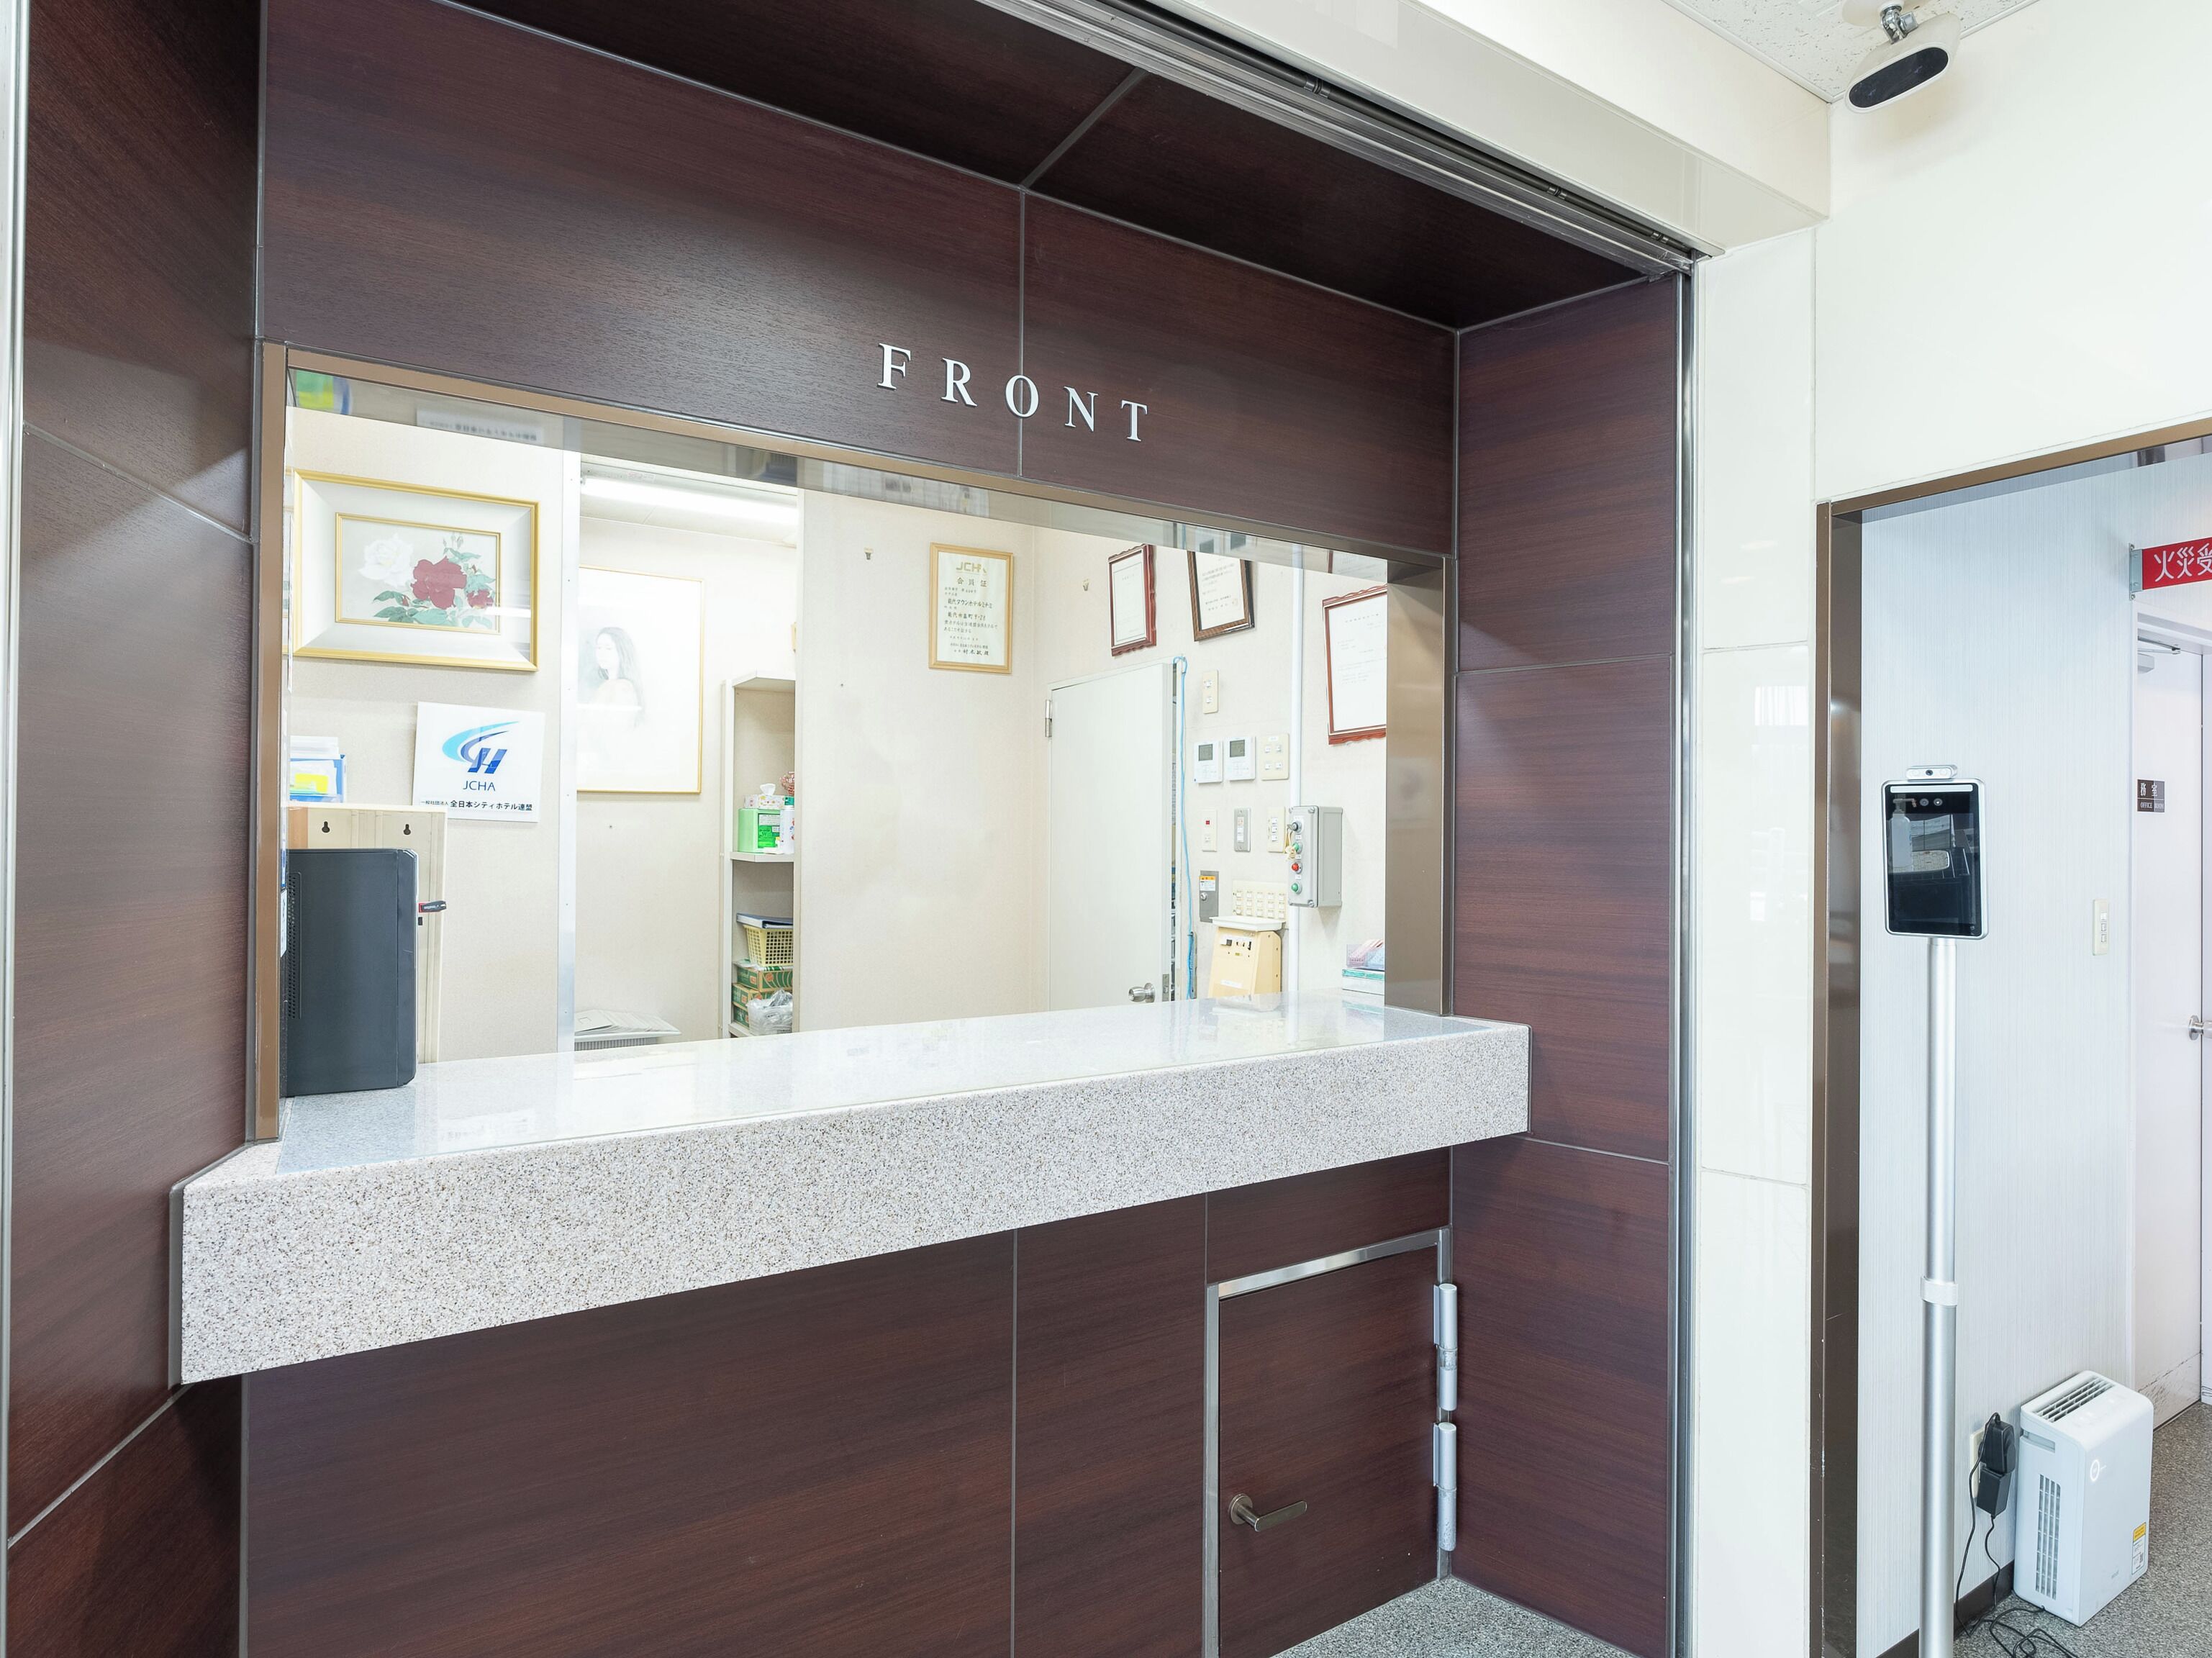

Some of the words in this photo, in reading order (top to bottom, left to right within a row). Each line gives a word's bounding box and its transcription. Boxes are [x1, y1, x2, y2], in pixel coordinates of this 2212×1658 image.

[877, 343, 1148, 442] FRONT
[2154, 543, 2212, 582] 火災受
[463, 781, 496, 792] JCHA
[450, 799, 532, 811] 全日本シティホテル連盟
